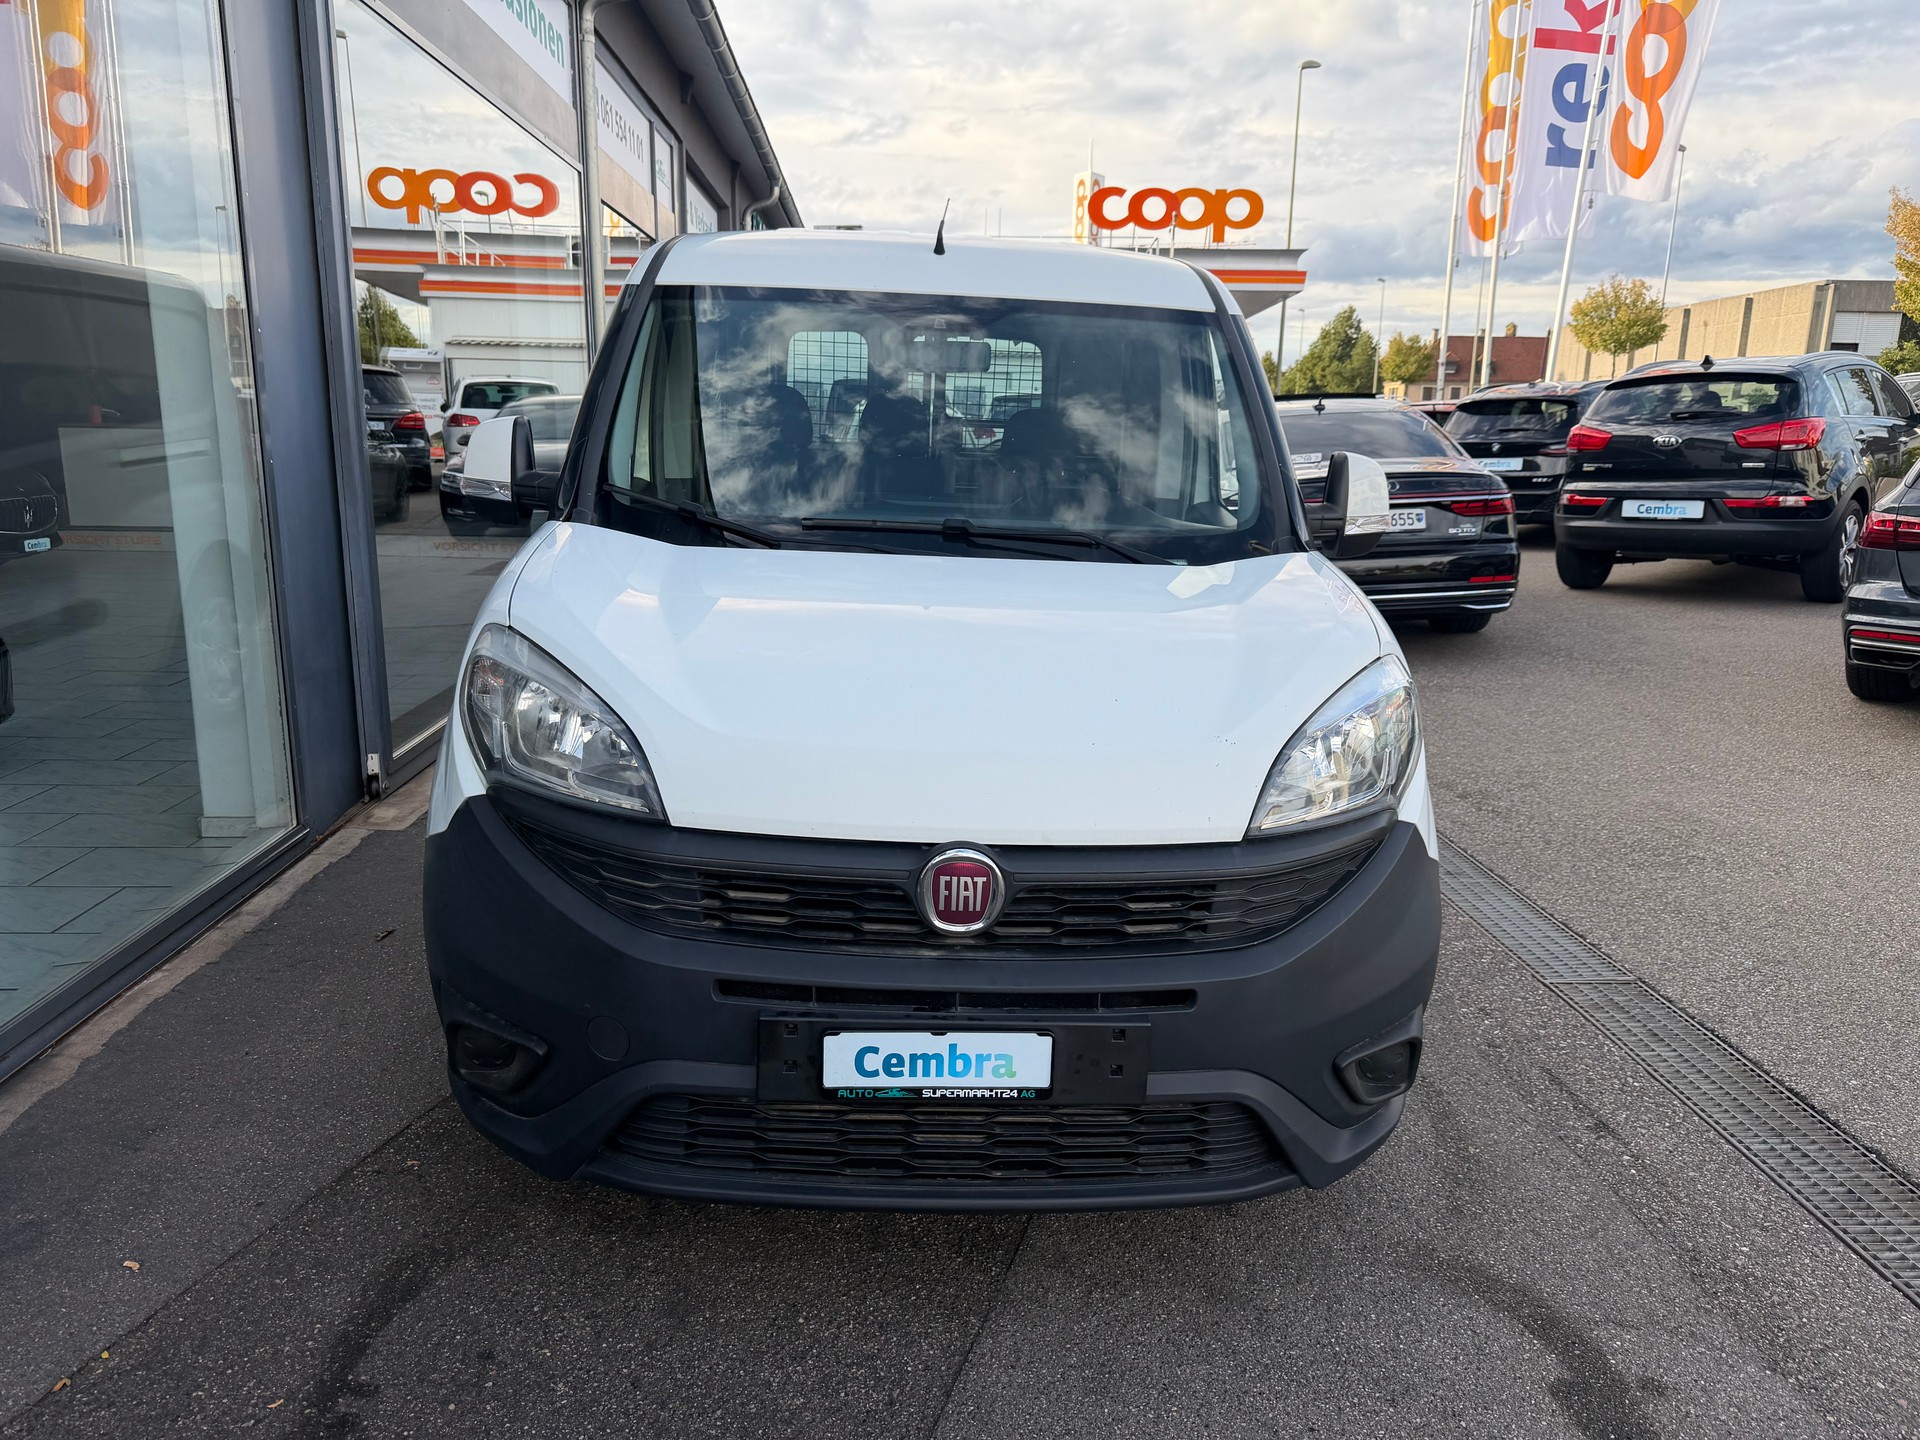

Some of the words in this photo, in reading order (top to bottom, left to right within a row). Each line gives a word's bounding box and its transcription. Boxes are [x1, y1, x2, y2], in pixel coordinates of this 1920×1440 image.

[1610, 0, 1700, 180] co
[600, 94, 614, 134] 061
[615, 109, 627, 147] 554
[628, 125, 636, 155] 11
[636, 133, 644, 164] 01
[1087, 186, 1264, 243] coop
[1656, 437, 1678, 447] KIA
[1390, 510, 1415, 528] 655
[1636, 503, 1687, 516] Cembra
[27, 540, 49, 550] Cembra
[938, 875, 987, 912] FIAT
[854, 1043, 1017, 1079] Cembra
[837, 1089, 874, 1098] AUTO
[922, 1089, 1018, 1098] SUPERMARKT24
[1020, 1089, 1036, 1098] AG
